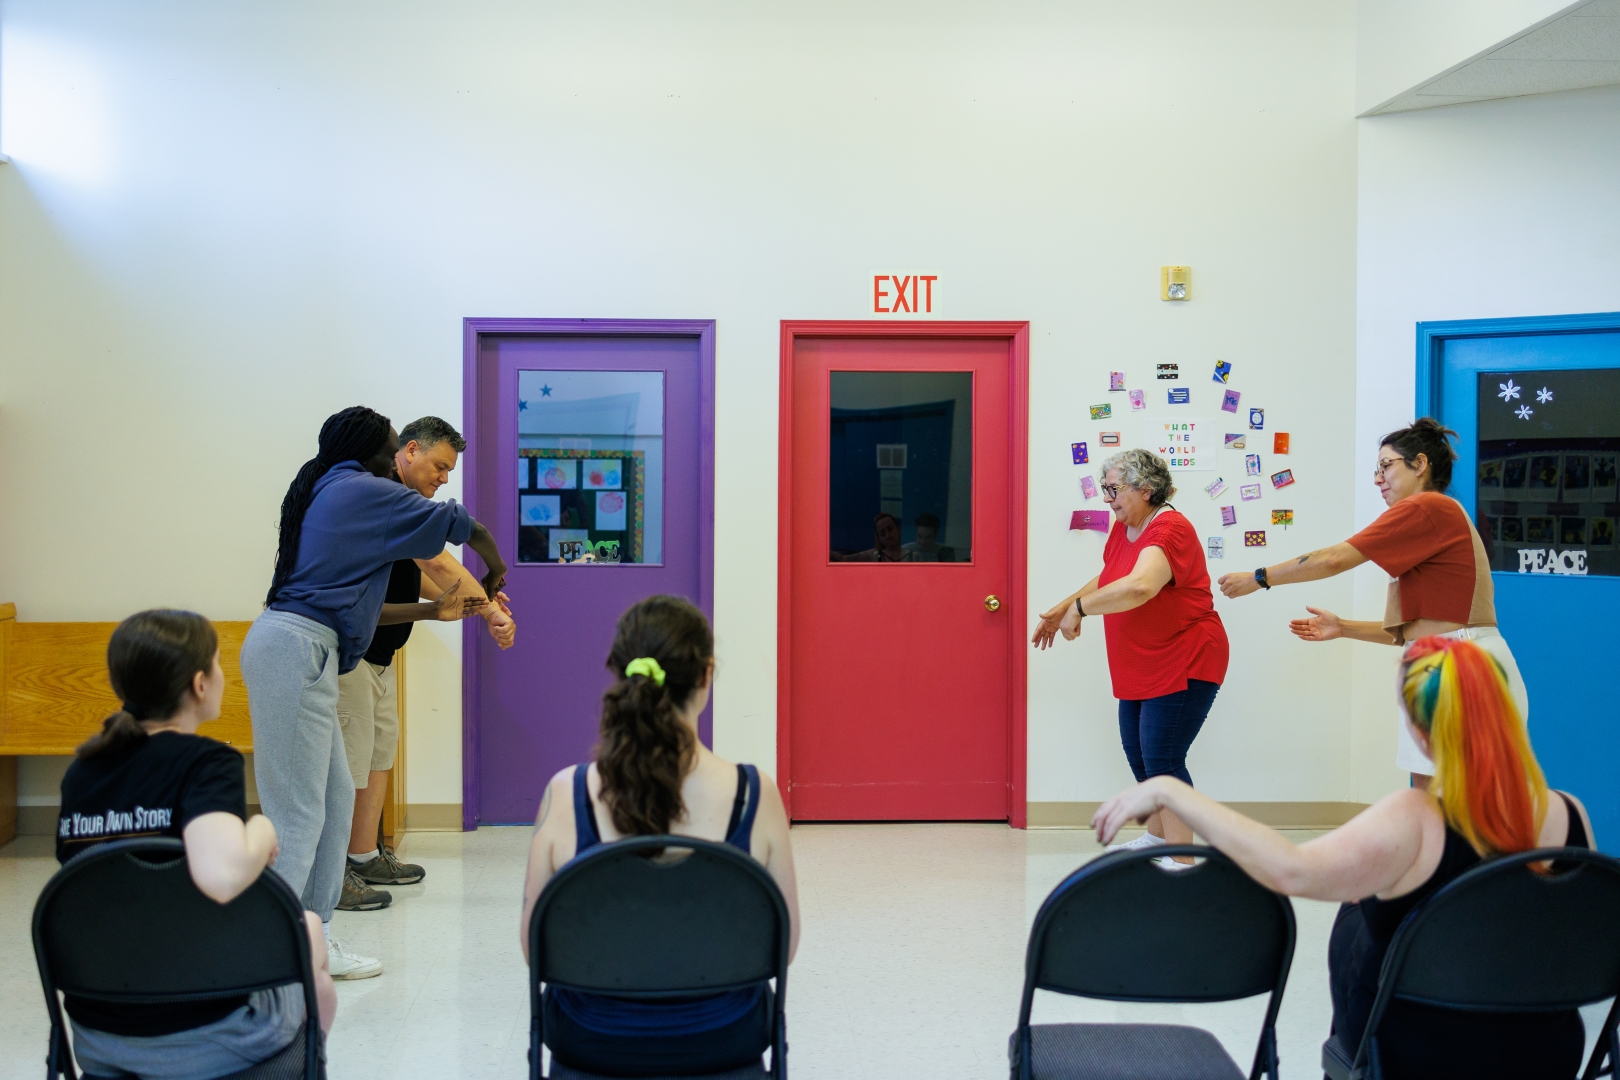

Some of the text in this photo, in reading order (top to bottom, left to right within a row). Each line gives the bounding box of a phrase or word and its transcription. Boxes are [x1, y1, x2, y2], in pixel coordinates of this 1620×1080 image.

[874, 275, 938, 313] EXIT
[1164, 423, 1195, 431] WHAT
[1168, 434, 1190, 442] THE
[1159, 446, 1196, 454] WORLD
[557, 539, 621, 564] PEACE
[1517, 548, 1588, 575] PEACE
